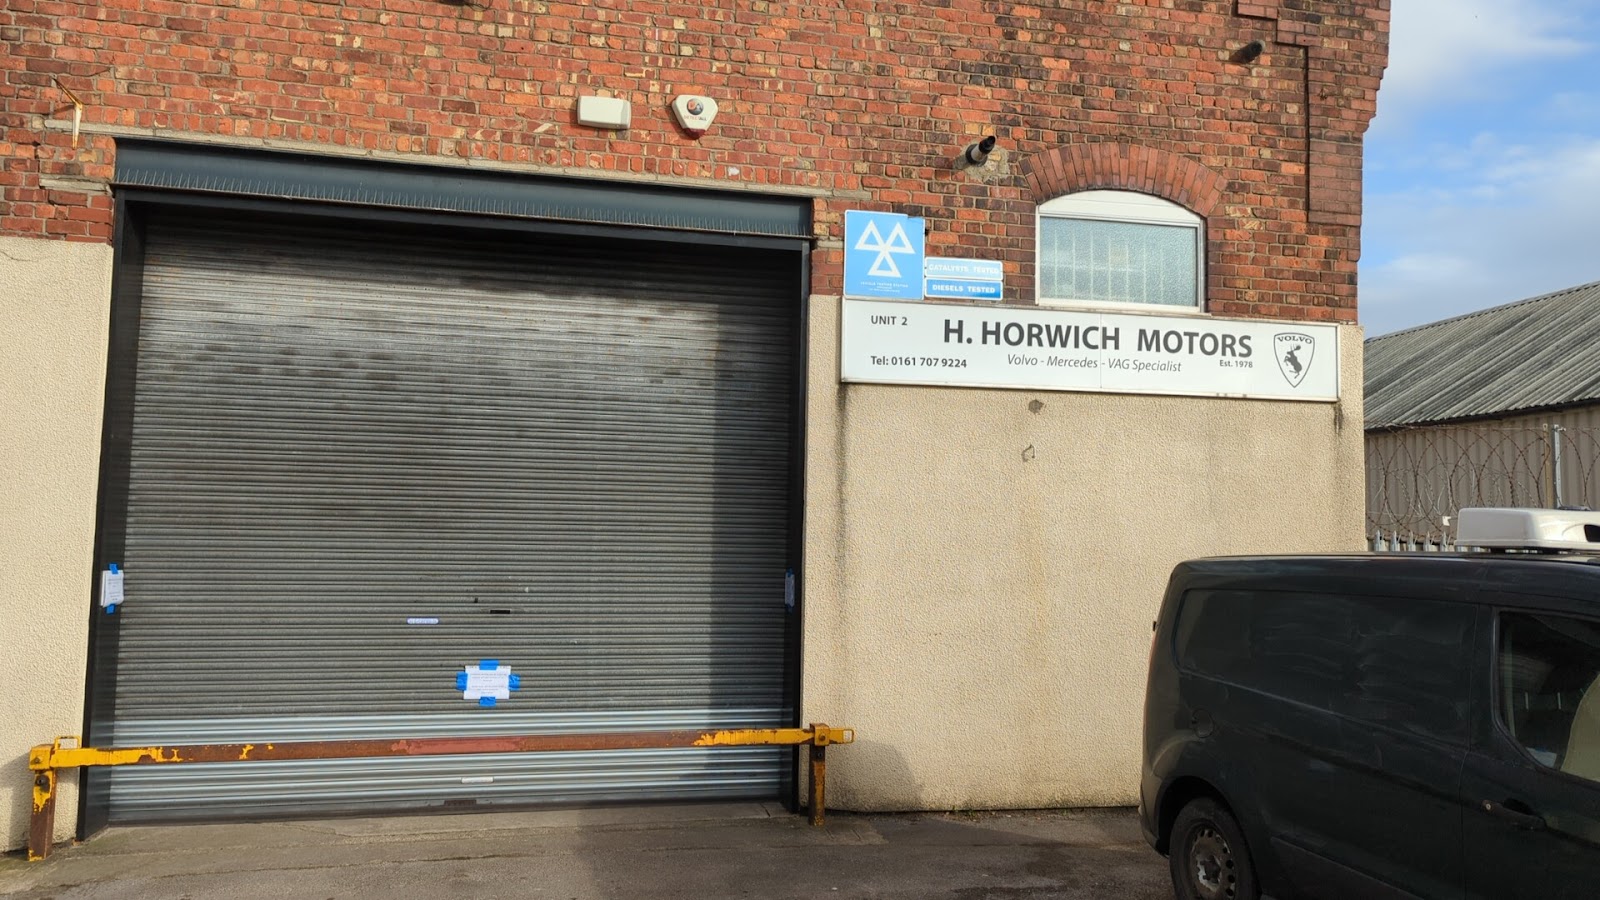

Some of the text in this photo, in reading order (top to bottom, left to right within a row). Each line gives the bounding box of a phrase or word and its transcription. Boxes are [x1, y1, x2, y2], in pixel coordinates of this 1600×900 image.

[973, 266, 999, 274] TESTED
[932, 284, 996, 293] DIESELS TESTED
[871, 315, 908, 326] UNIT 2
[944, 319, 1253, 358] H. HORWICH MOTORS
[1277, 335, 1312, 344] VOLVO
[870, 355, 967, 368] Tel: 0161 707 9224
[1008, 354, 1038, 365] Volvo
[1047, 356, 1098, 368] Mercedes
[1109, 358, 1130, 369] VAG
[1132, 359, 1181, 372] Specialist
[1220, 359, 1253, 368] Est. 1978
